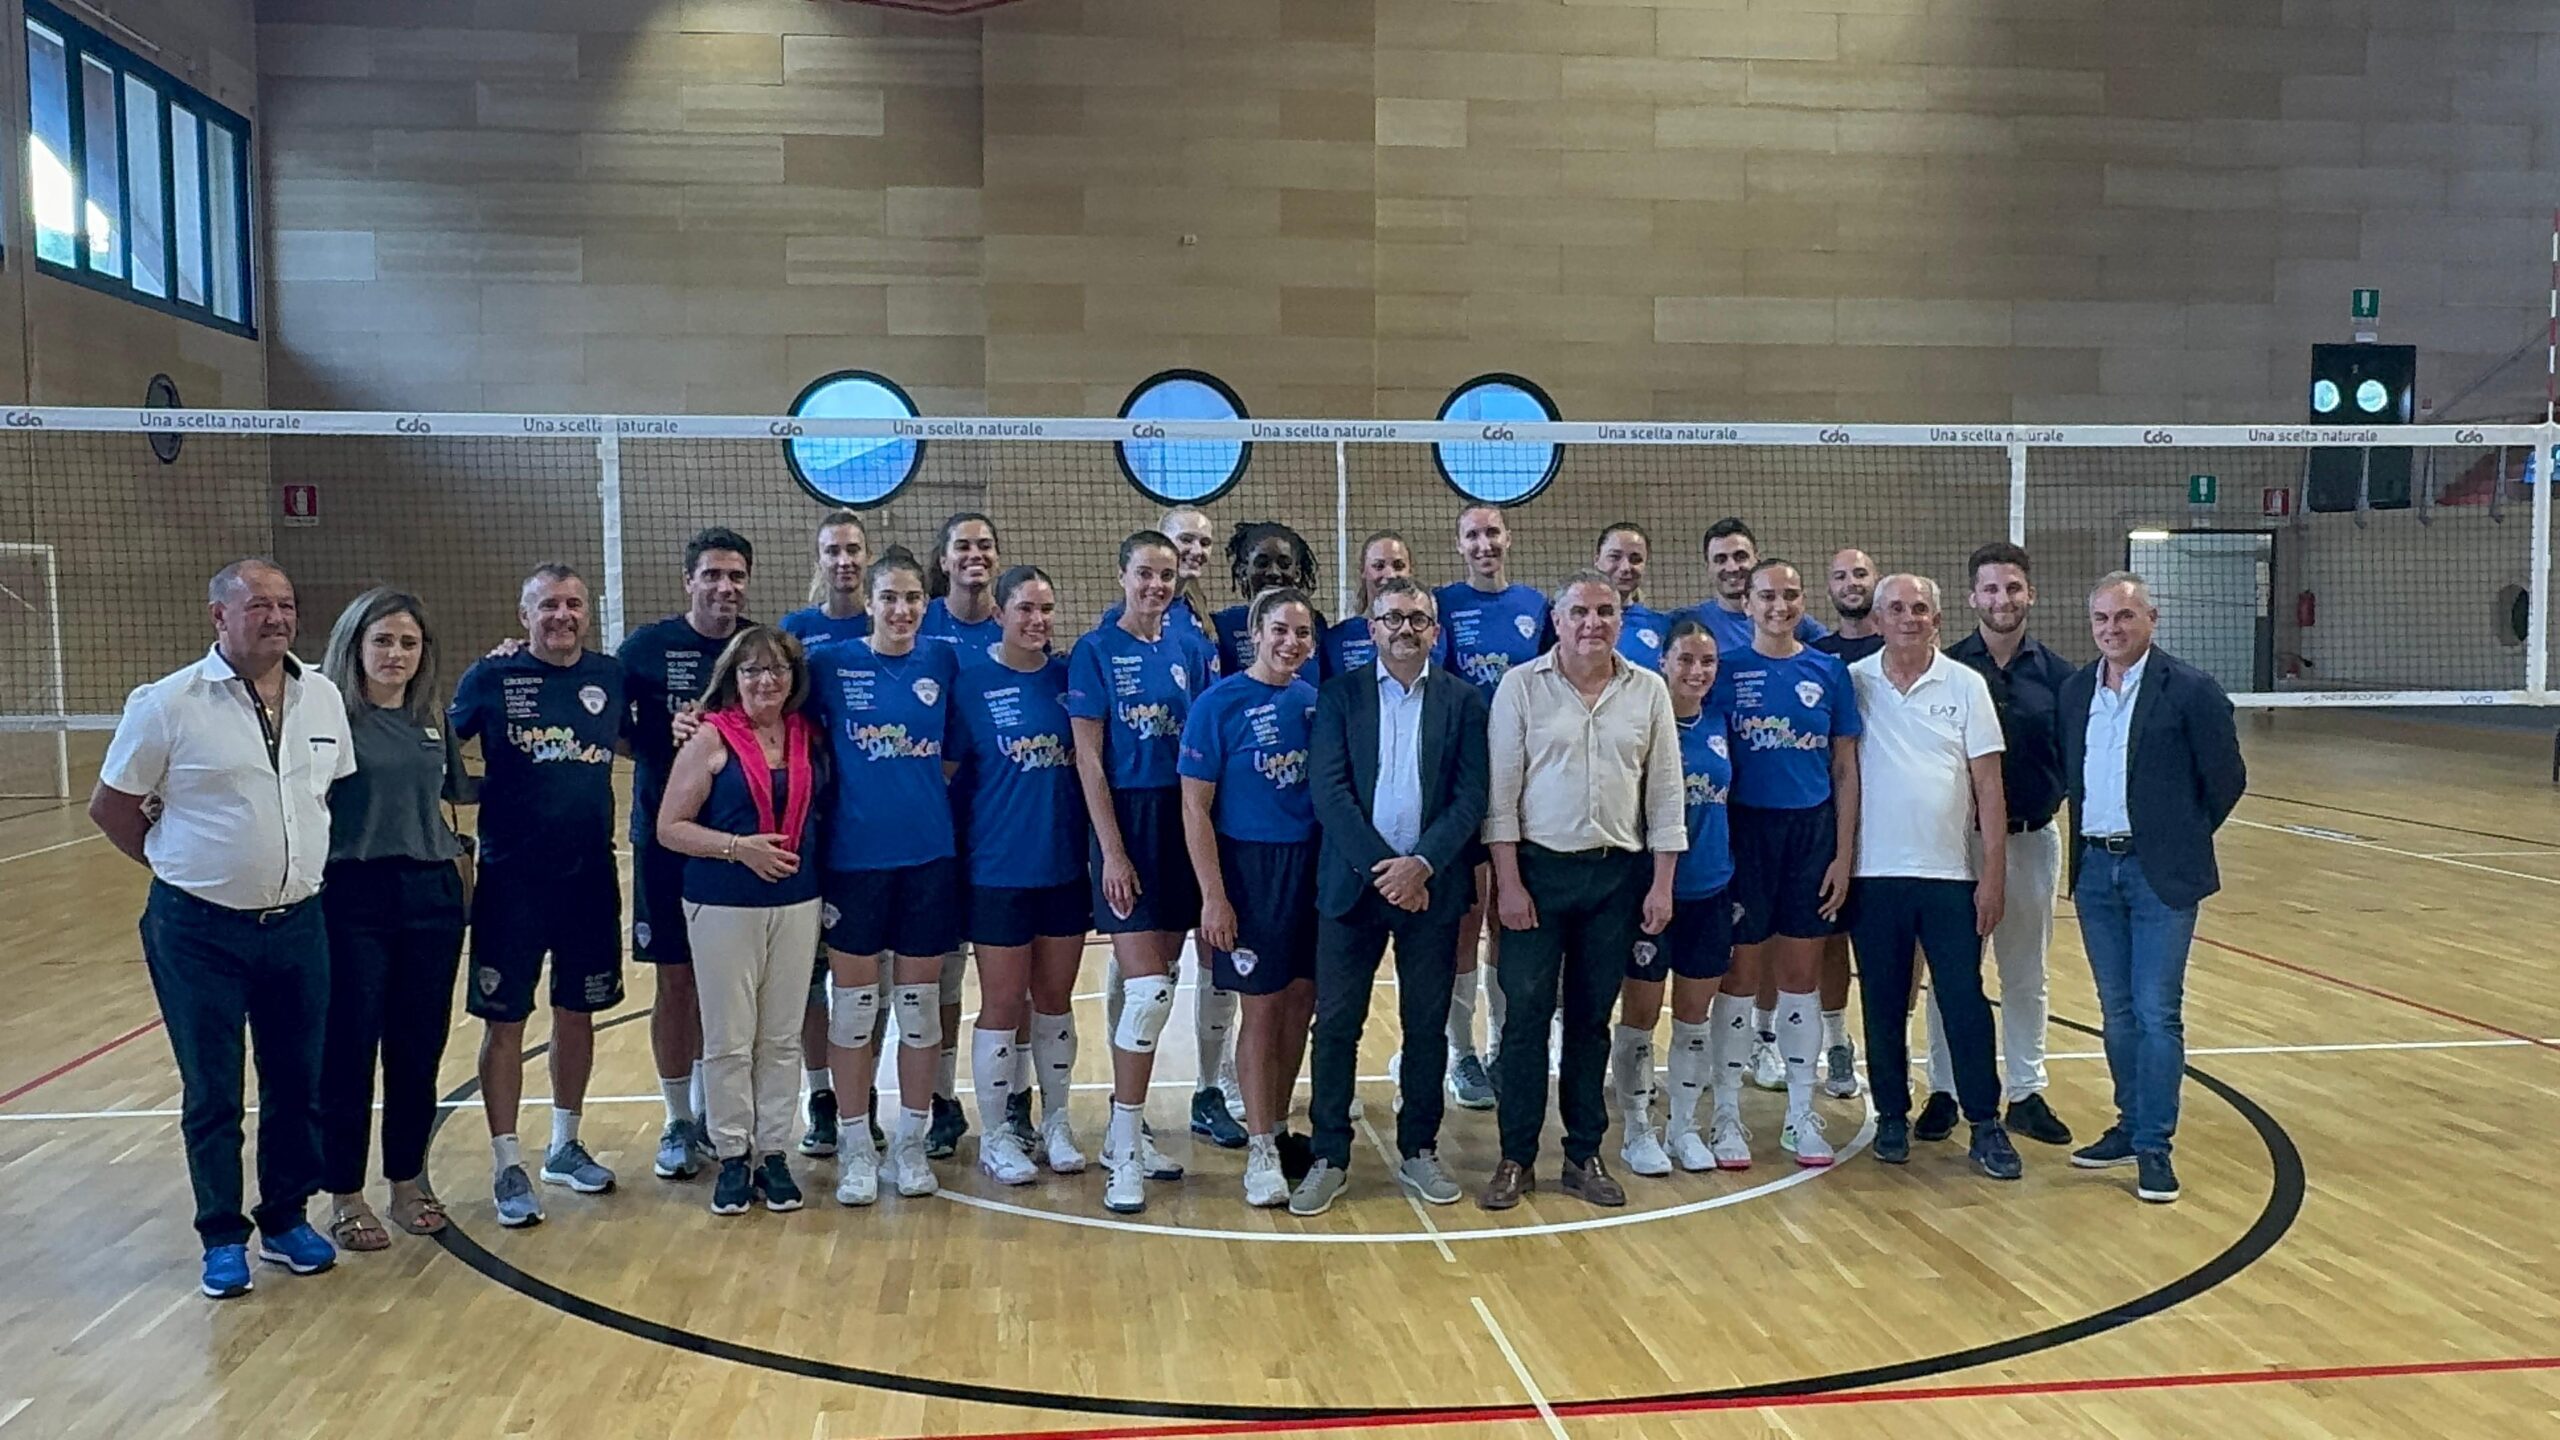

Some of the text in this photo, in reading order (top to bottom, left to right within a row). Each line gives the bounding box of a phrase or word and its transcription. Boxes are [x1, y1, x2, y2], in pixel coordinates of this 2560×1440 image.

[139, 412, 301, 429] Una scelta naturale
[523, 417, 554, 432] Una
[893, 420, 1043, 436] Una scelta naturale
[1251, 424, 1396, 438] Una scelta naturale
[1598, 426, 1738, 440] Una scelta naturale
[1930, 428, 2064, 442] Una scelta nurale
[2249, 429, 2378, 443] Una scelta naturale
[1930, 704, 1957, 718] EA7
